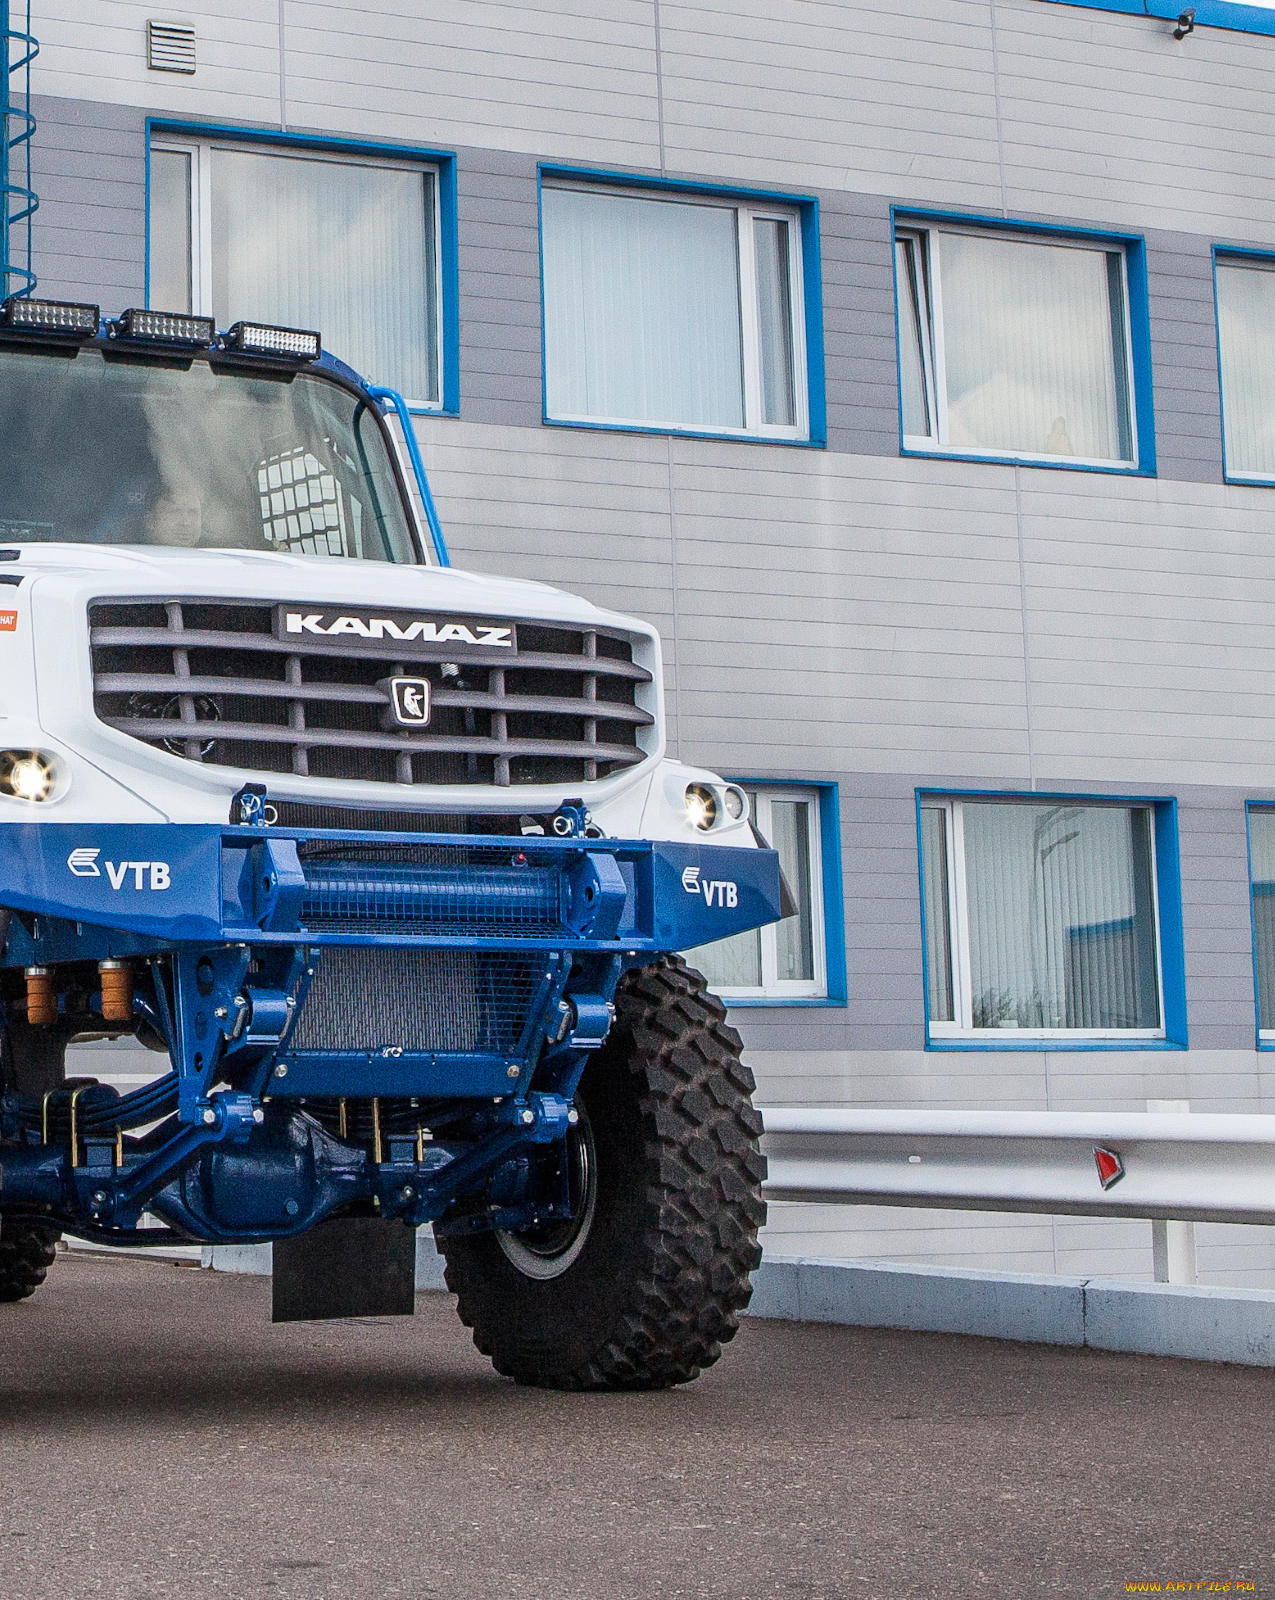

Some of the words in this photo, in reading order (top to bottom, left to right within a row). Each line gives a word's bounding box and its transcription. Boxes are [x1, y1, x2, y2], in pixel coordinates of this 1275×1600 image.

[286, 613, 511, 647] KAMAZ
[104, 861, 171, 890] VTB
[701, 879, 738, 908] VTB
